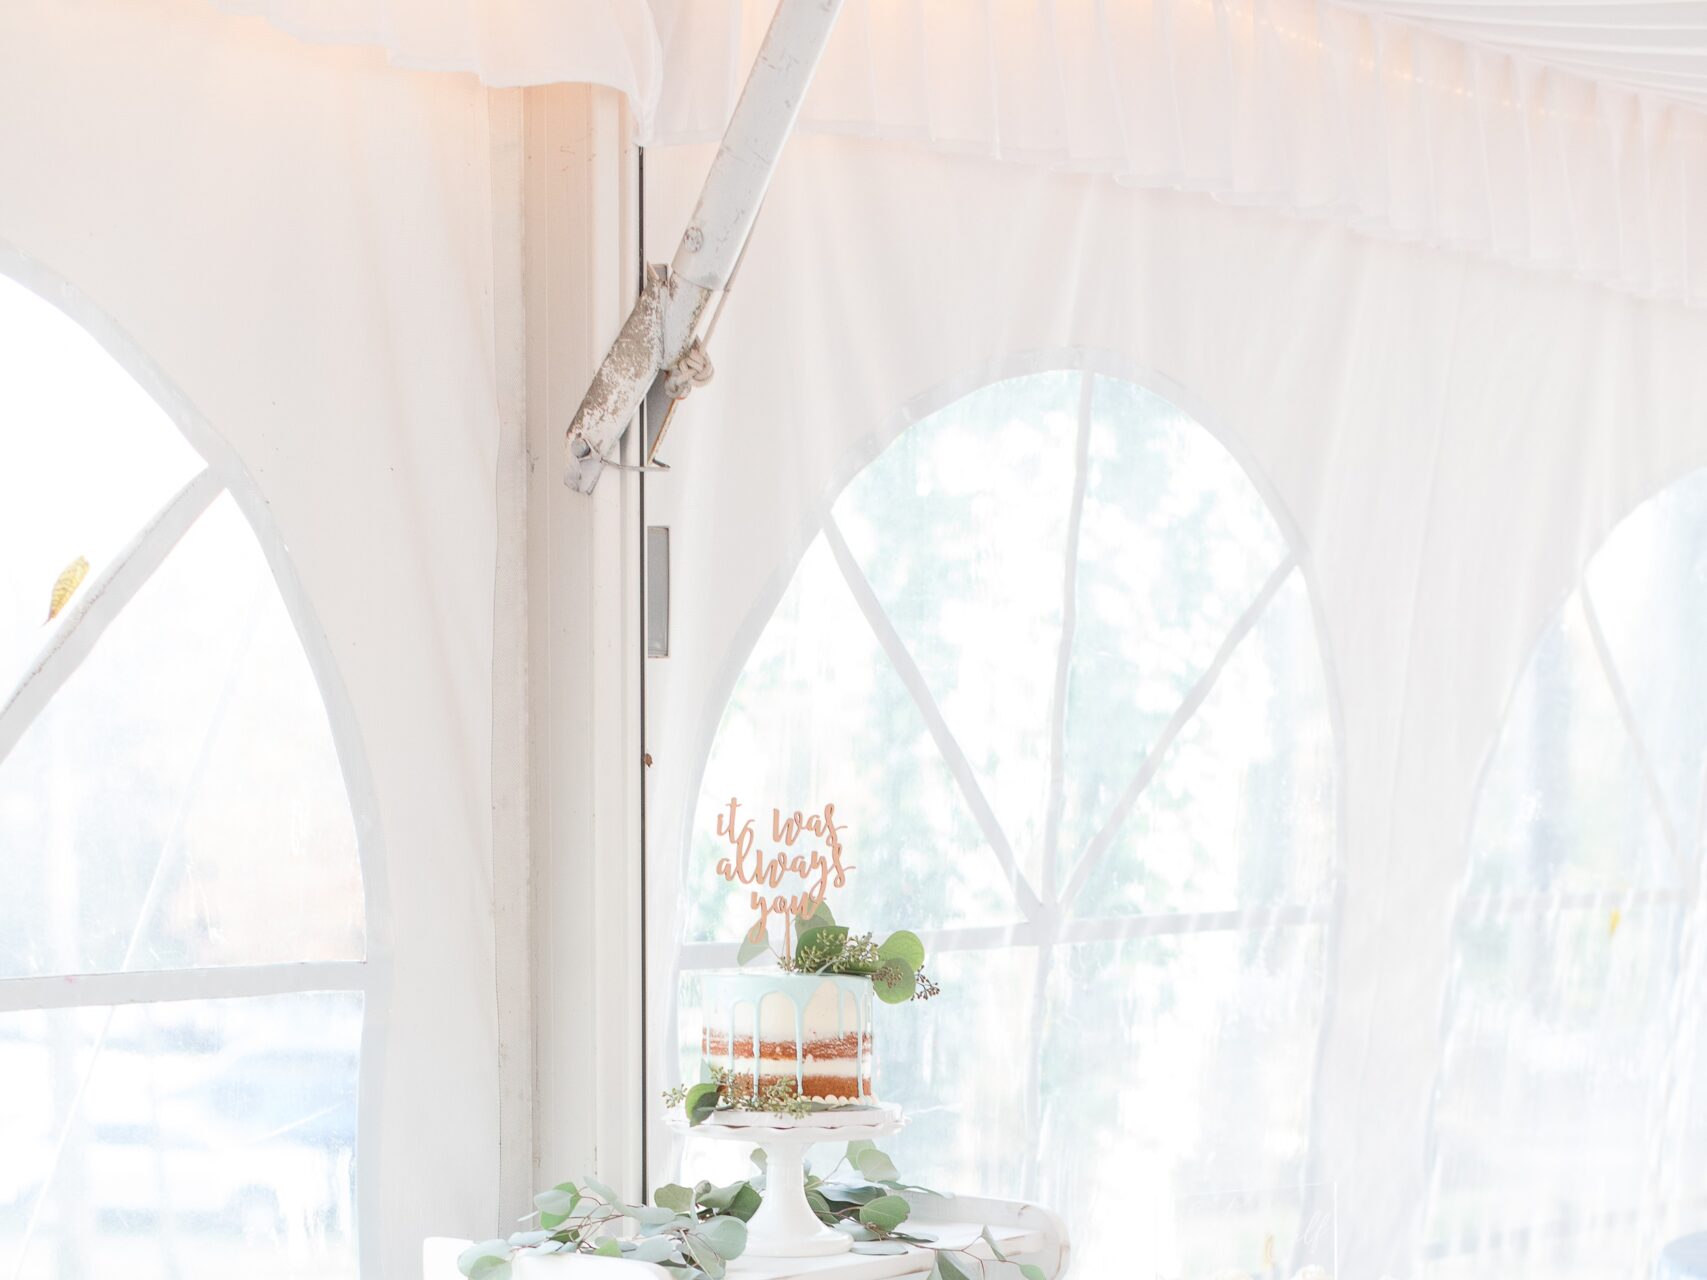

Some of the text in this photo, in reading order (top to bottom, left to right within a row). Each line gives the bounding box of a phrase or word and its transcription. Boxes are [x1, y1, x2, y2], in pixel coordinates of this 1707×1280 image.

[717, 797, 848, 847] it was
[716, 819, 856, 902] always
[748, 890, 826, 944] you
